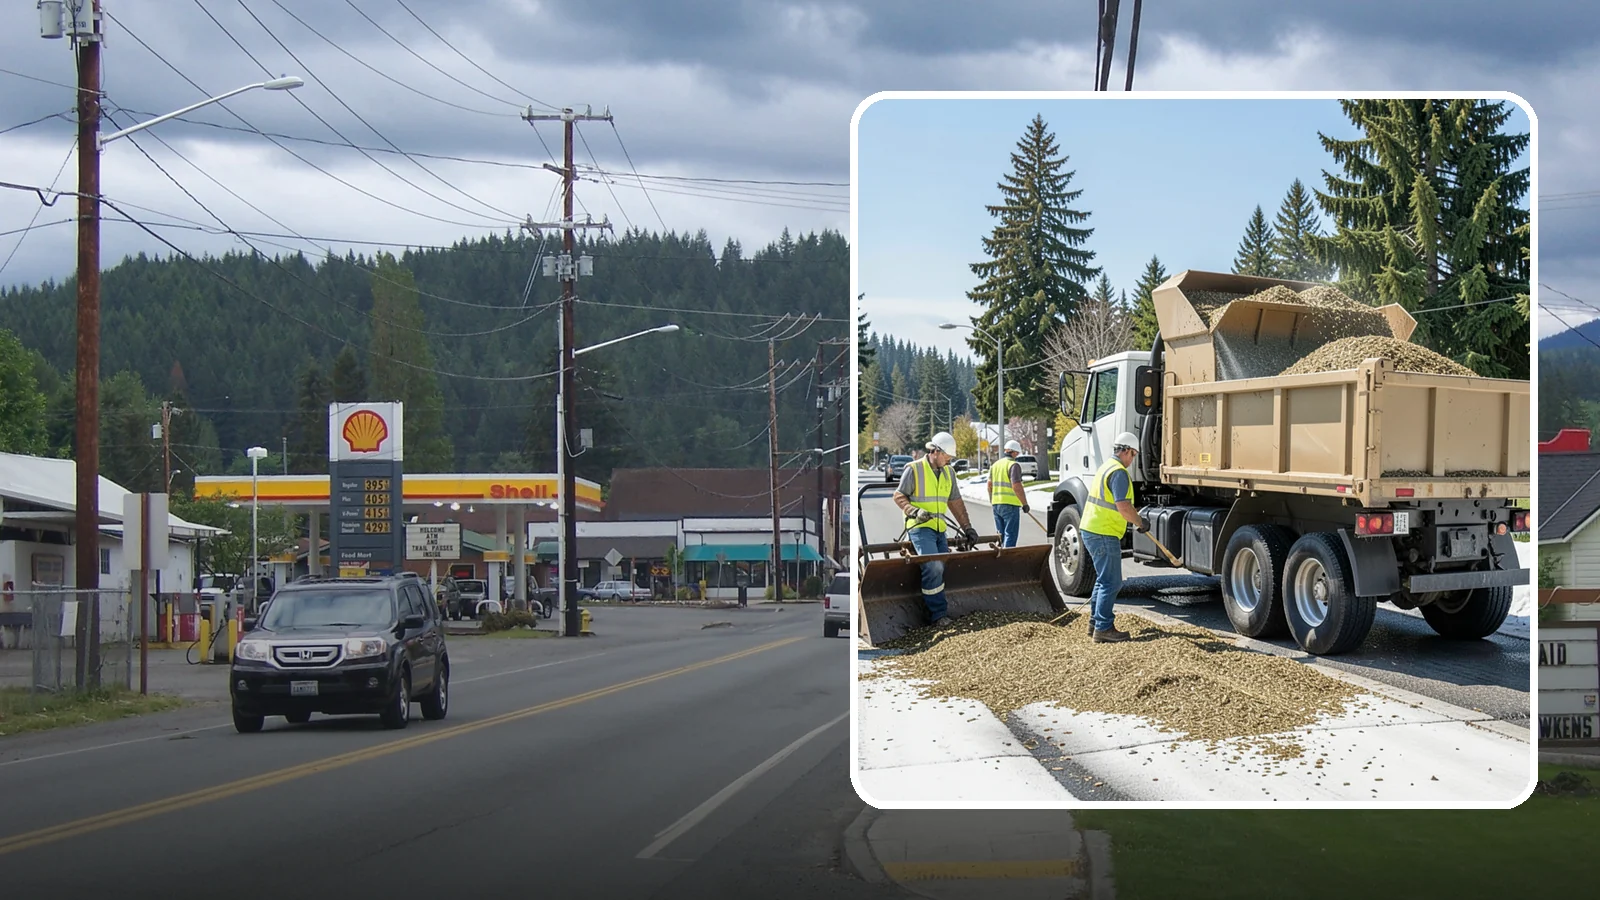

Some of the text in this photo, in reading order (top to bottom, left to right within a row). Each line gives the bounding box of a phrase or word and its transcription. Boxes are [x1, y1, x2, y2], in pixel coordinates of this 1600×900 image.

[365, 480, 383, 490] 395
[490, 484, 547, 499] Shell
[365, 494, 383, 504] 405
[365, 508, 383, 518] 415
[365, 522, 383, 532] 429
